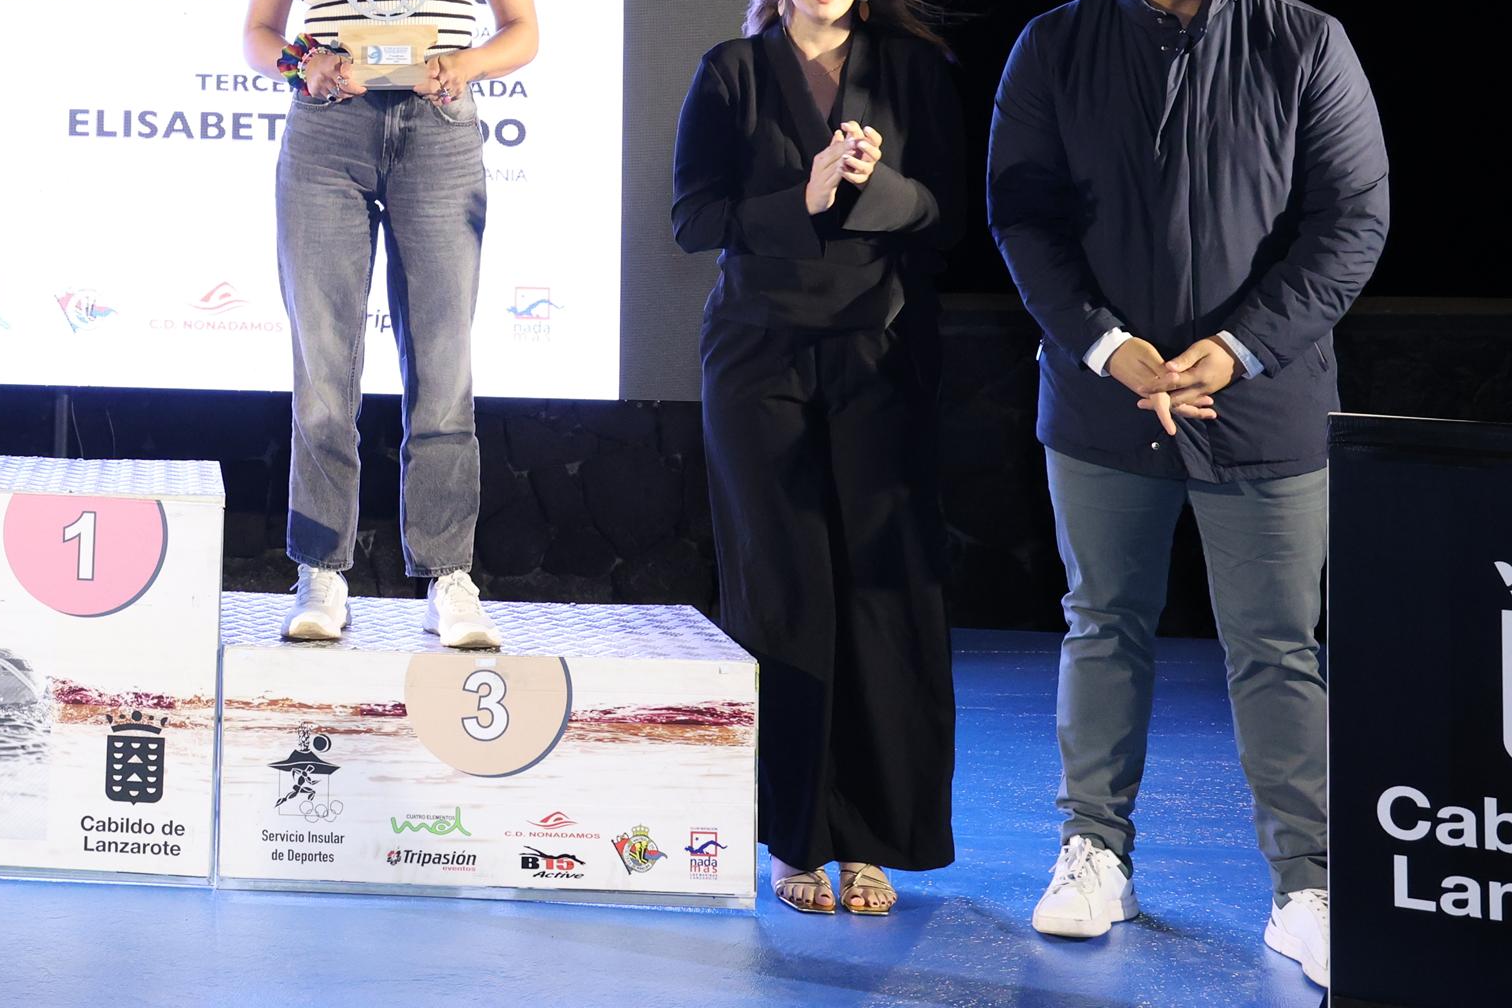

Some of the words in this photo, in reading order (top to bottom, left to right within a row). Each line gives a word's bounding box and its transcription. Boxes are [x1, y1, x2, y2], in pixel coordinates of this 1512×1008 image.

[195, 73, 286, 93] TERCE
[183, 319, 284, 333] NONADAMOS
[61, 510, 97, 581] 1
[460, 669, 510, 742] 3
[80, 815, 156, 836] Cabildo
[161, 819, 186, 838] de
[1376, 785, 1512, 854] Cab
[261, 829, 305, 843] Servicio
[307, 830, 345, 844] Insular
[529, 832, 601, 840] NONADAMOS
[83, 836, 182, 857] Lanzarote
[271, 849, 284, 861] de
[287, 849, 335, 864] Deportes
[403, 849, 477, 867] Tripasión
[690, 855, 718, 867] nada
[532, 870, 585, 879] Active
